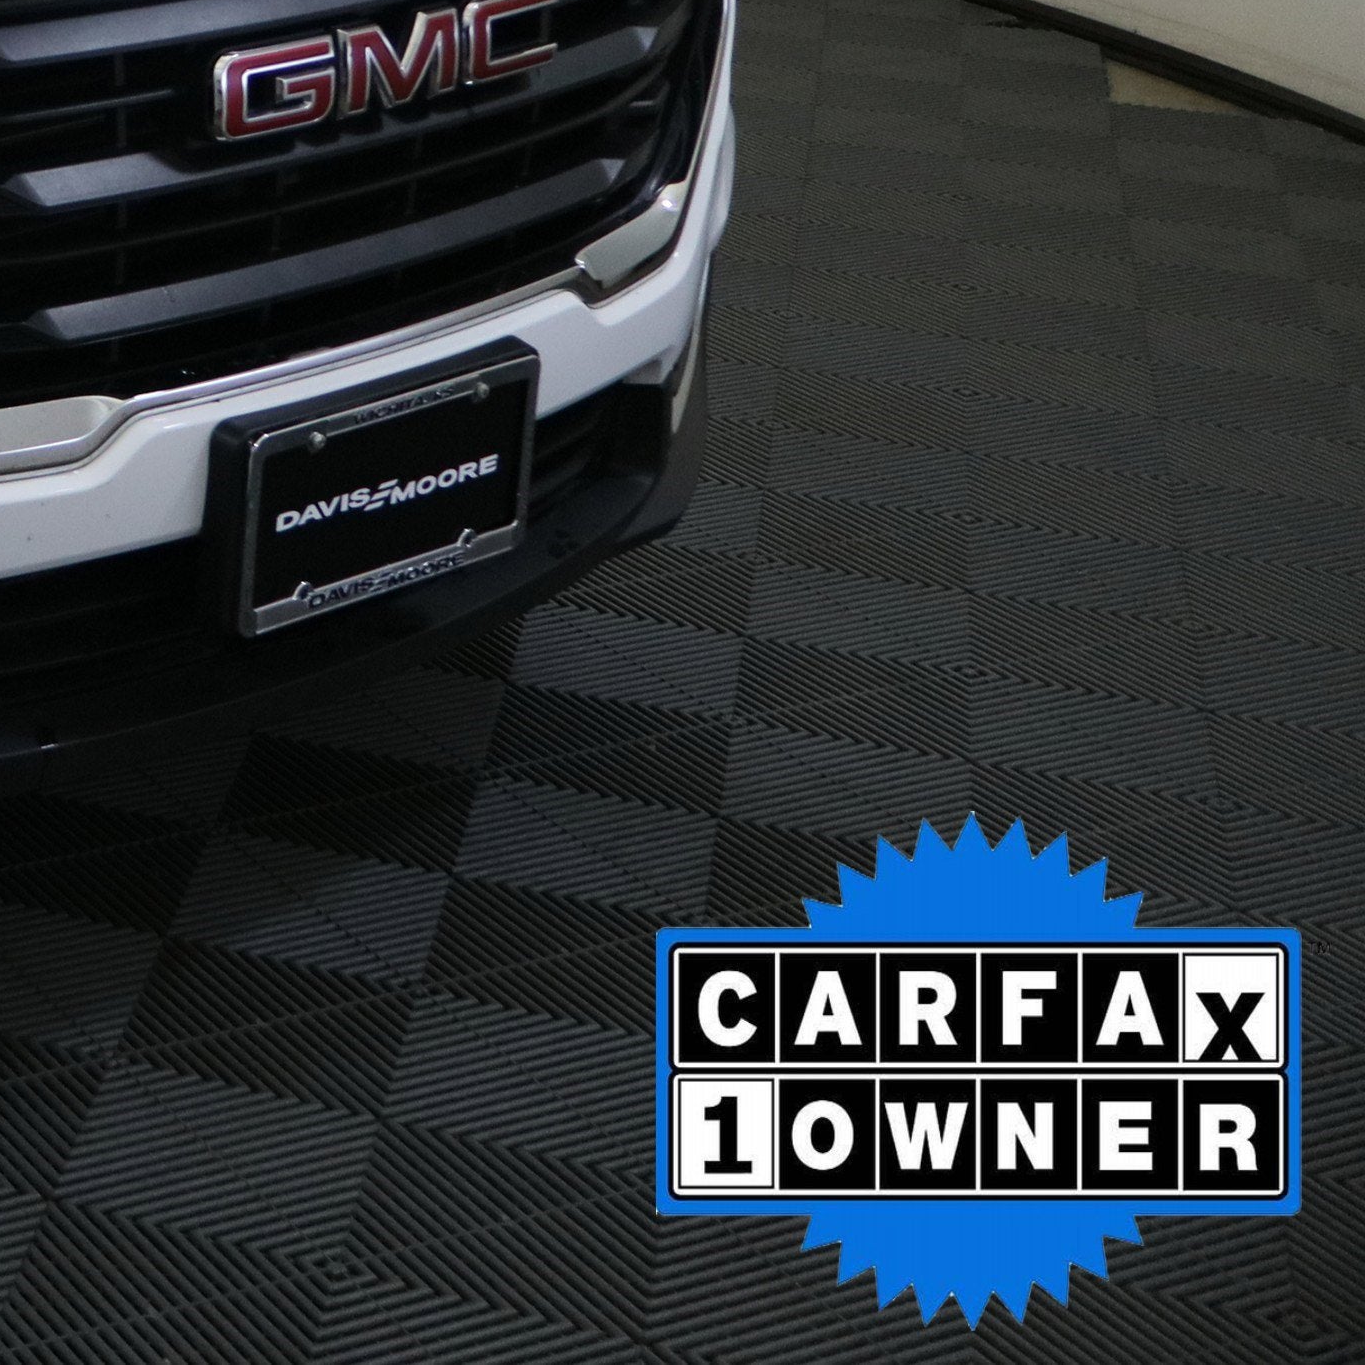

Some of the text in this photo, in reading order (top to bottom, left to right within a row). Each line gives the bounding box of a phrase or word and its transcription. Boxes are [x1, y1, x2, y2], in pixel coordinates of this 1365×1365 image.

[275, 453, 499, 533] DAVIS MOORE
[386, 550, 466, 588] MOORE
